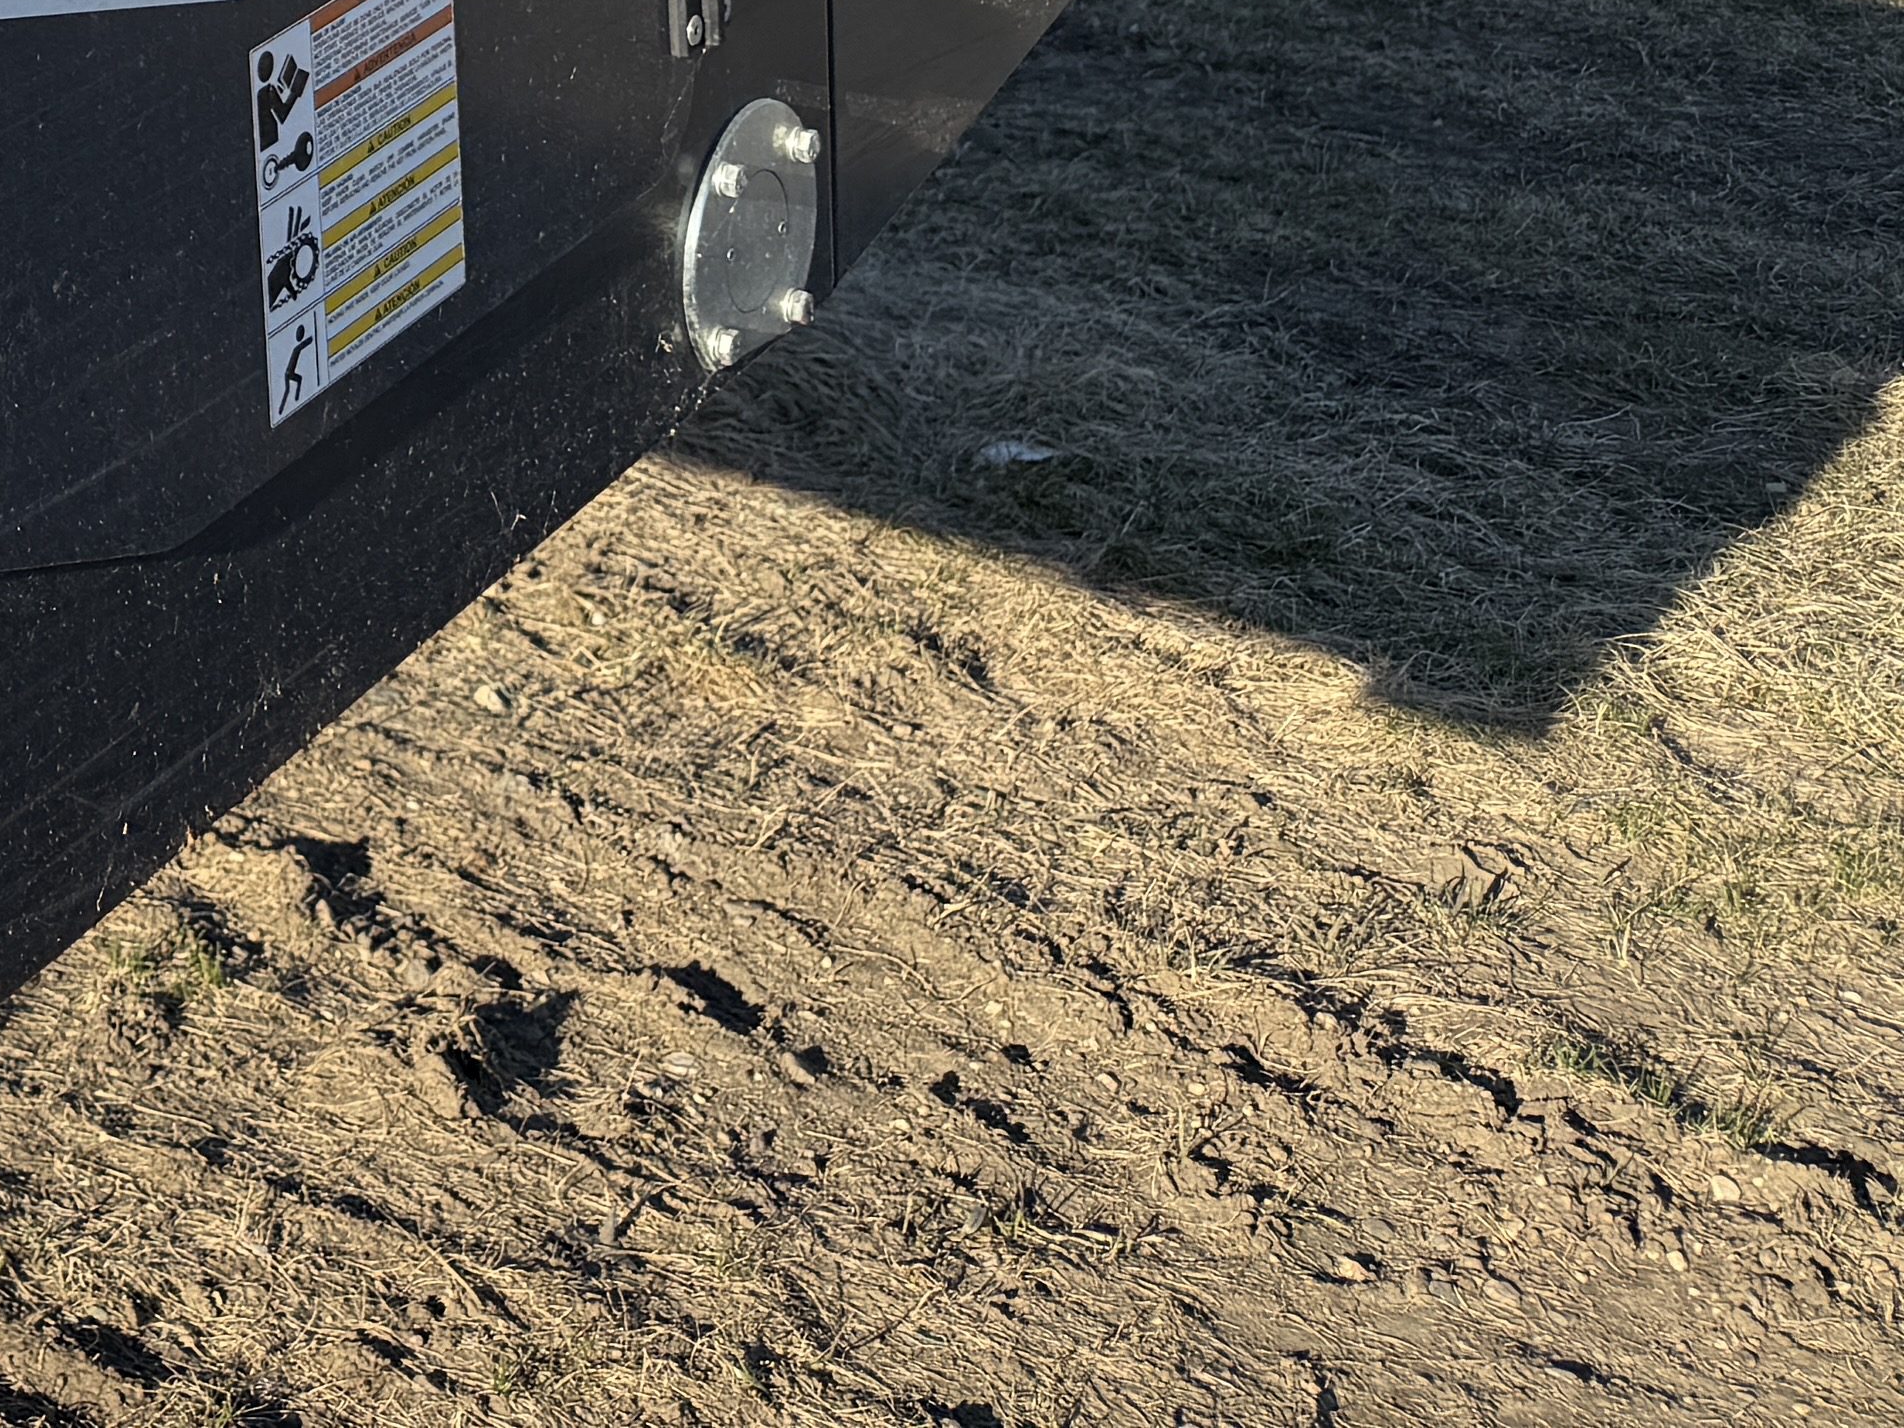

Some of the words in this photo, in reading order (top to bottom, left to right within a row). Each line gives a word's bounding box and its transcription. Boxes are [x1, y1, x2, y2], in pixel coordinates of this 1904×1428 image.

[377, 115, 412, 146] CAUTION
[377, 175, 415, 209] ATENCIÓN
[383, 238, 417, 269] CAUTION
[382, 280, 420, 315] ATENCIÓN
